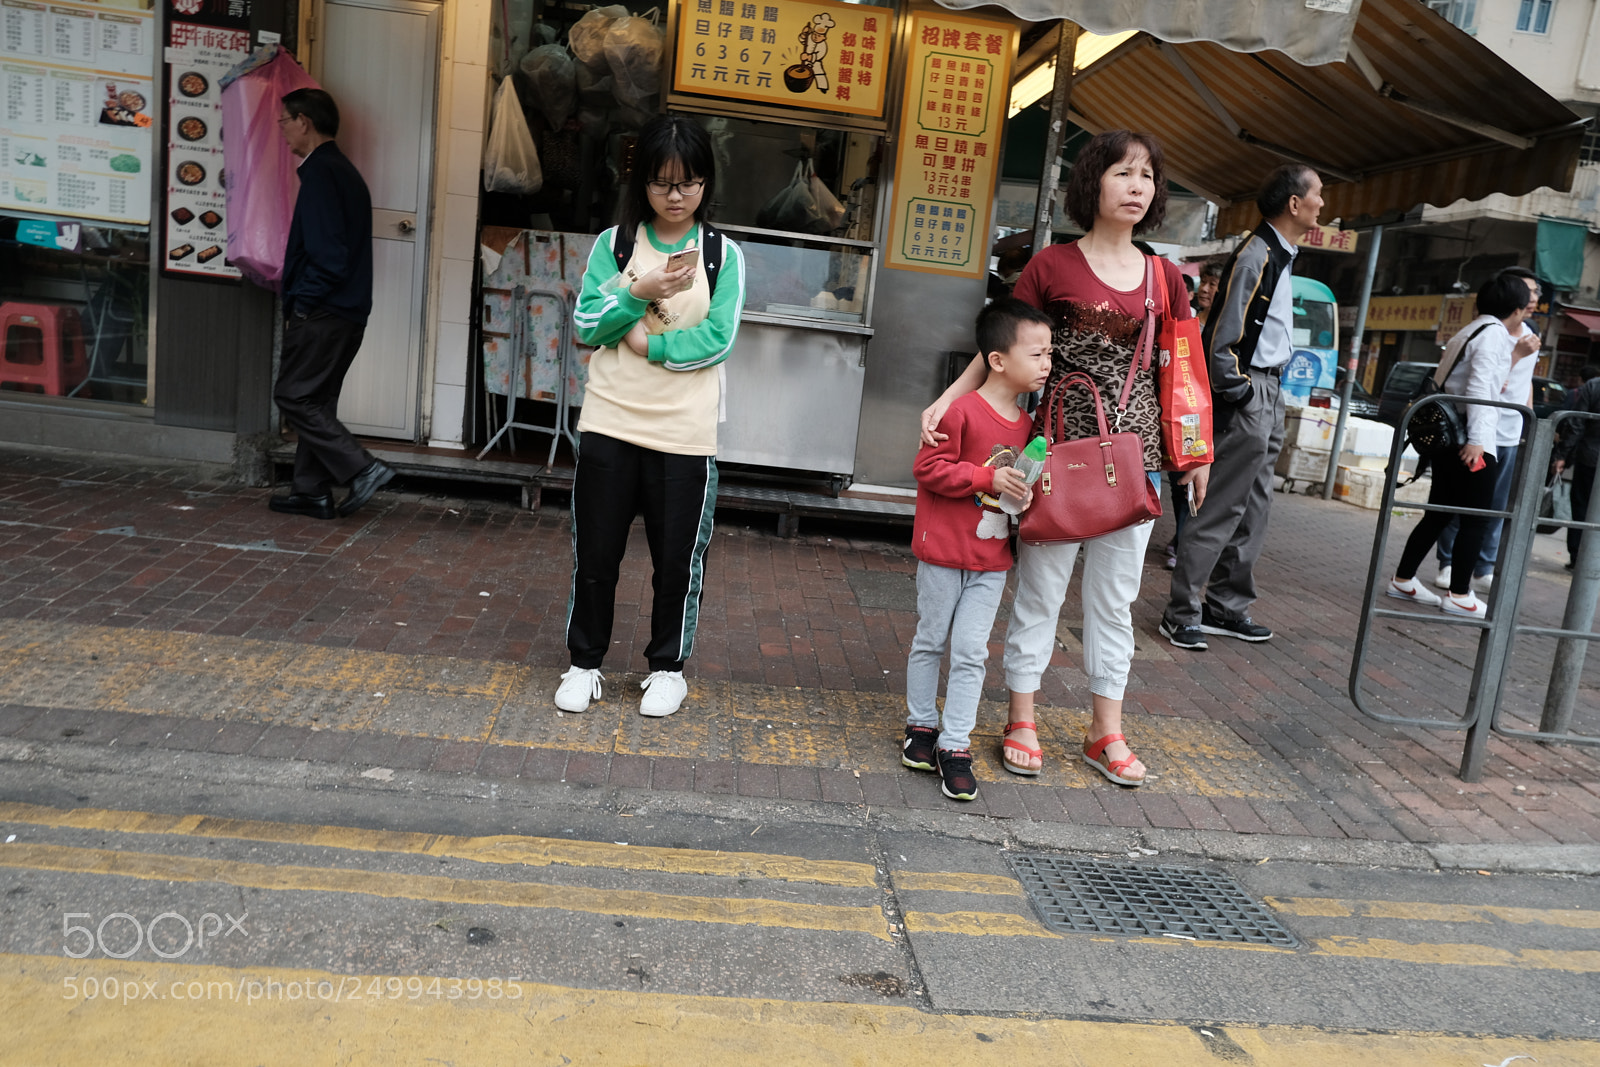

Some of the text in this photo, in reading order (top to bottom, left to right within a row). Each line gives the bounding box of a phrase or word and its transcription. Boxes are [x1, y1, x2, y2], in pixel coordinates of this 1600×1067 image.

[921, 25, 1004, 56] 招牌套餐
[937, 116, 968, 131] 13元
[914, 134, 988, 158] 魚旦燒賣
[922, 152, 976, 173] 可雙拼
[1303, 227, 1352, 250] 地產
[1287, 367, 1315, 380] ICE
